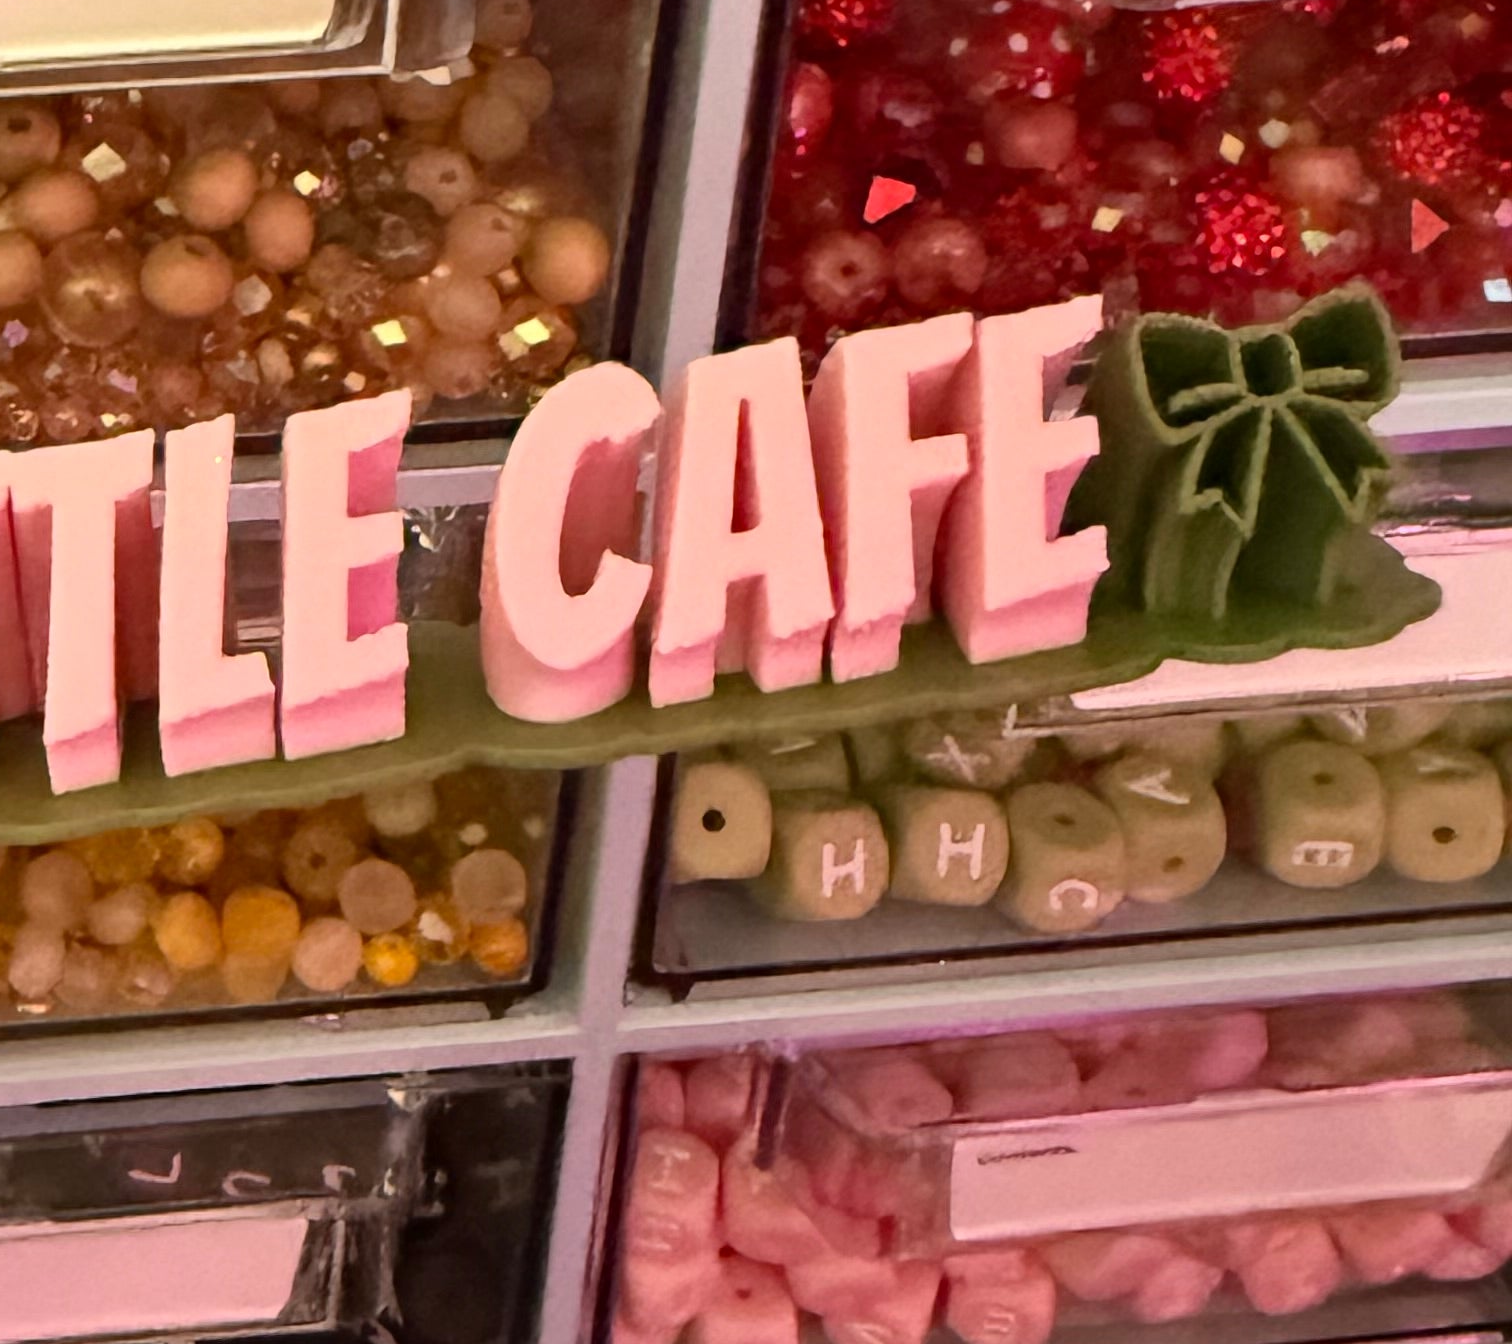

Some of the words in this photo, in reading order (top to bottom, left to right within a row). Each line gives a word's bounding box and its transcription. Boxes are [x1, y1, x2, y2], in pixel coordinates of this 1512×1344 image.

[486, 294, 1110, 706] CAFE
[821, 838, 865, 899] H
[936, 822, 986, 881] H
